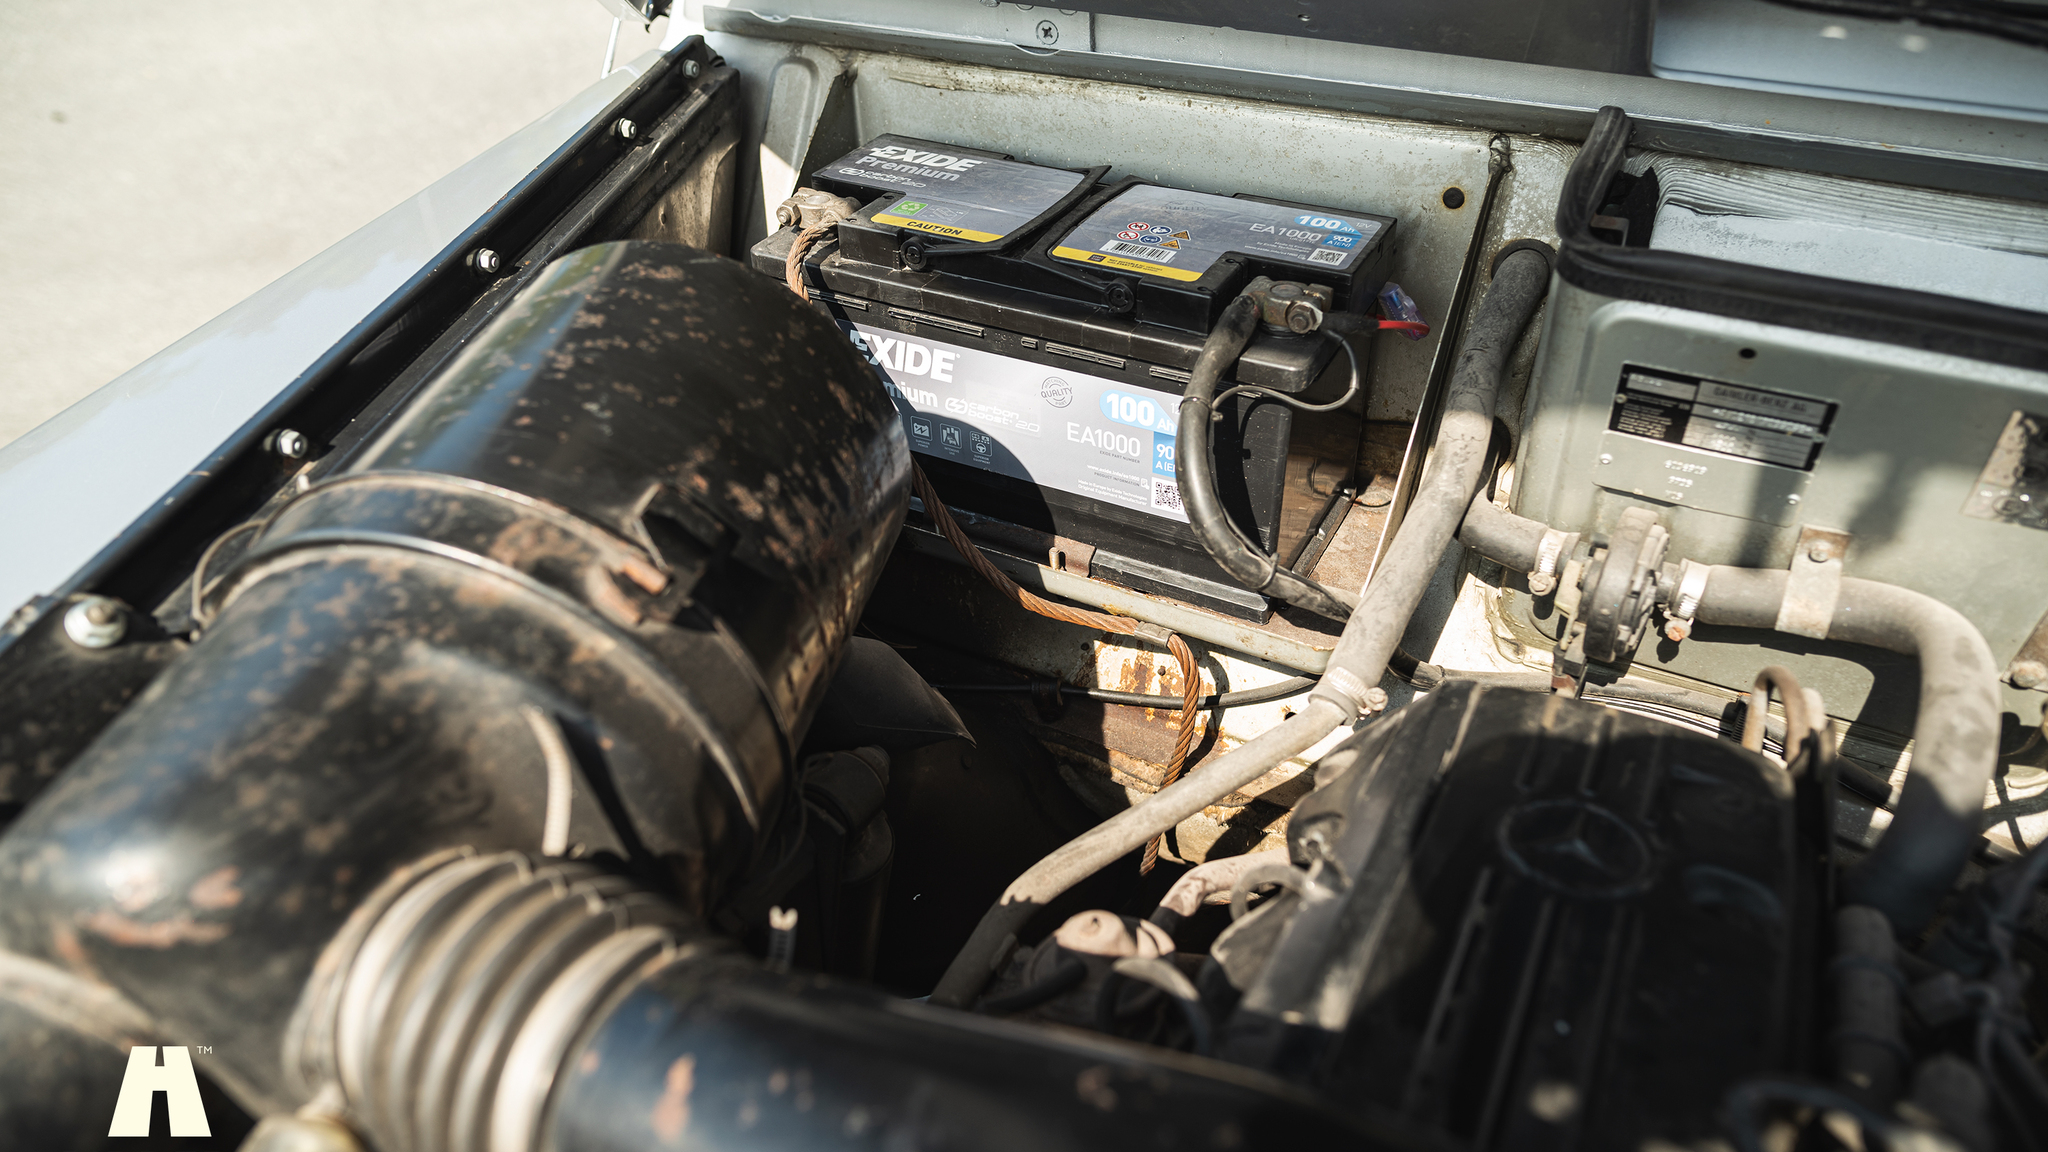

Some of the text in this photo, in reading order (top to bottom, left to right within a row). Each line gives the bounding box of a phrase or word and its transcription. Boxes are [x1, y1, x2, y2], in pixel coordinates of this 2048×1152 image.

[869, 145, 984, 172] EXIDE
[855, 156, 960, 181] Premium
[907, 221, 963, 236] CAUTION
[1299, 215, 1341, 229] 100
[1249, 223, 1322, 241] EA1000
[1333, 235, 1352, 243] 900
[850, 329, 956, 383] EXIDE
[883, 381, 938, 407] mium
[1040, 387, 1073, 398] QUALITY
[968, 401, 1019, 420] carbon
[1106, 393, 1175, 432] 100 Ah
[1171, 402, 1180, 414] 12
[1067, 421, 1141, 457] EA1000
[1123, 456, 1140, 464] NUMBER
[1156, 443, 1175, 460] 90
[1155, 461, 1163, 469] A
[1094, 472, 1140, 487] PRODUCT INFORMATION
